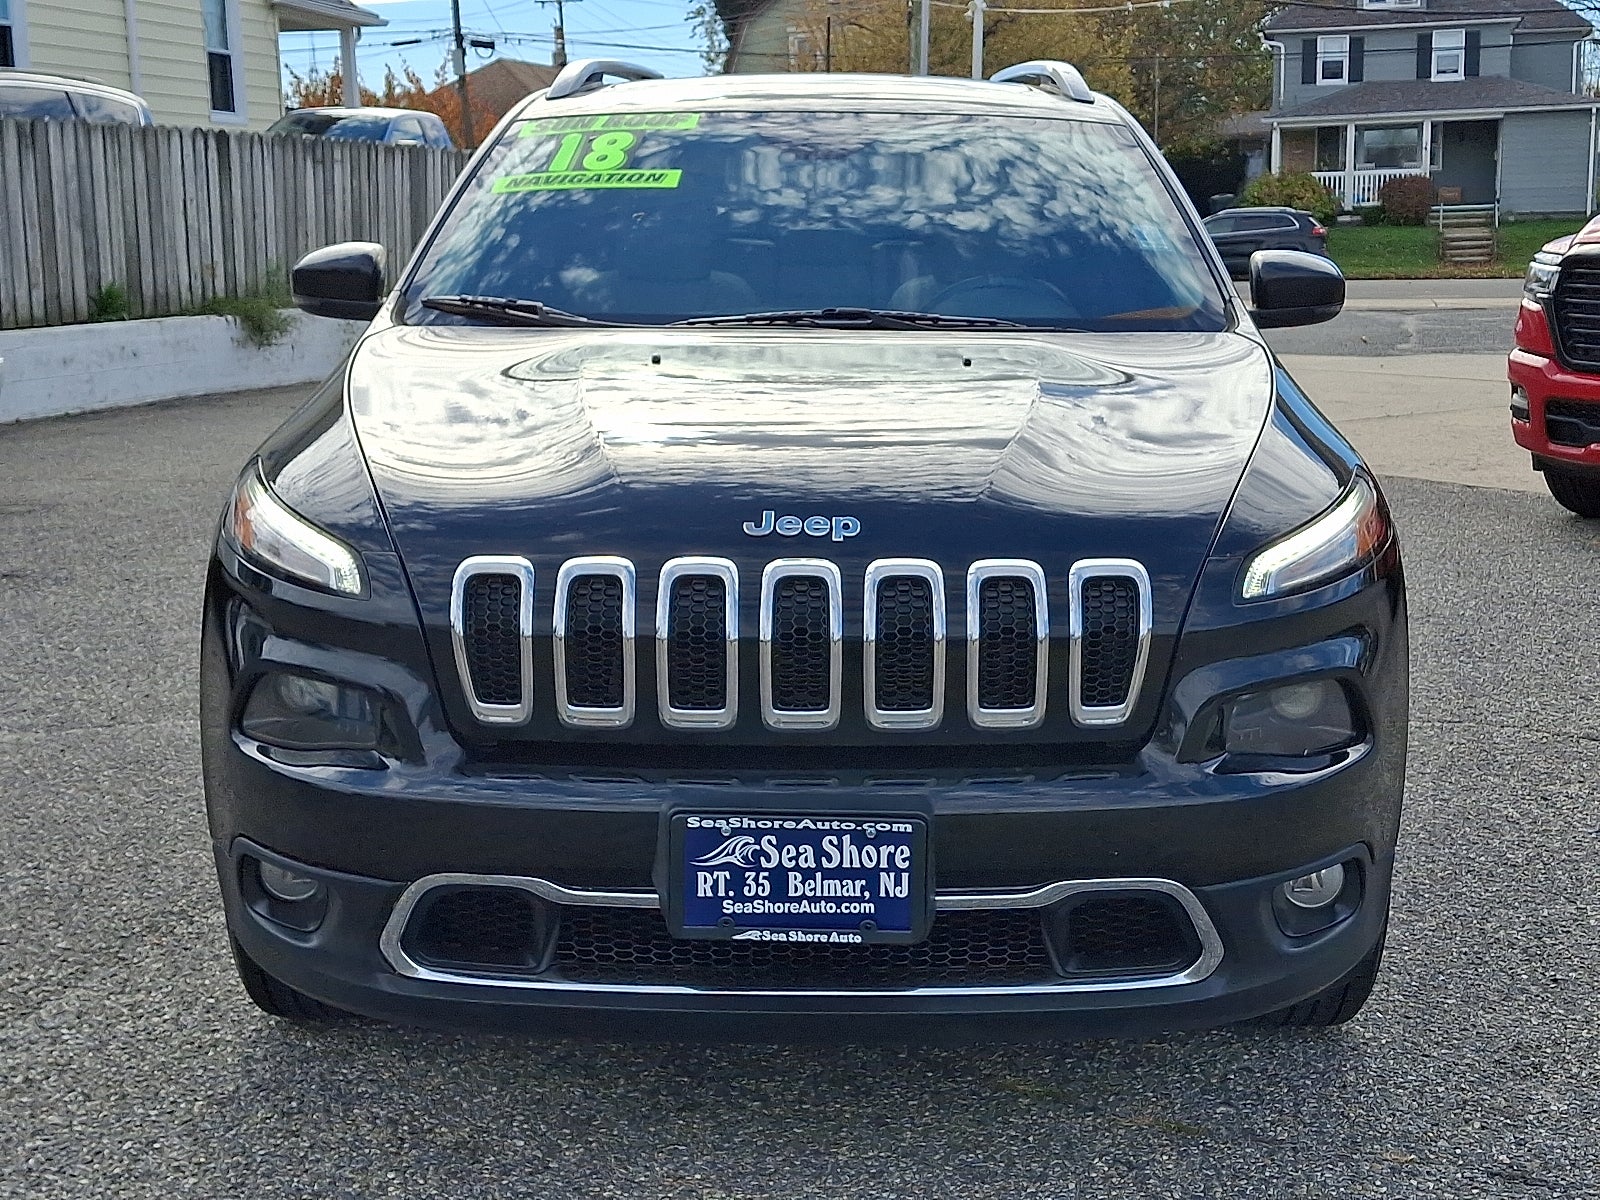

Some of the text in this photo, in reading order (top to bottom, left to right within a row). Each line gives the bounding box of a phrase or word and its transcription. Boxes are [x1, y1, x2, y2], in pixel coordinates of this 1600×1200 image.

[534, 113, 692, 133] SUN ROOF
[548, 131, 635, 172] 18
[505, 172, 668, 188] NAVIGATION
[743, 510, 860, 541] Jeep
[687, 817, 912, 833] SeaShoreAuto.com
[760, 834, 911, 869] Sea Shore
[697, 871, 910, 900] RT. 35 Belmar, NJ
[722, 900, 875, 914] SeaShoreAuto.com
[762, 930, 862, 943] Sea Shore Auto
